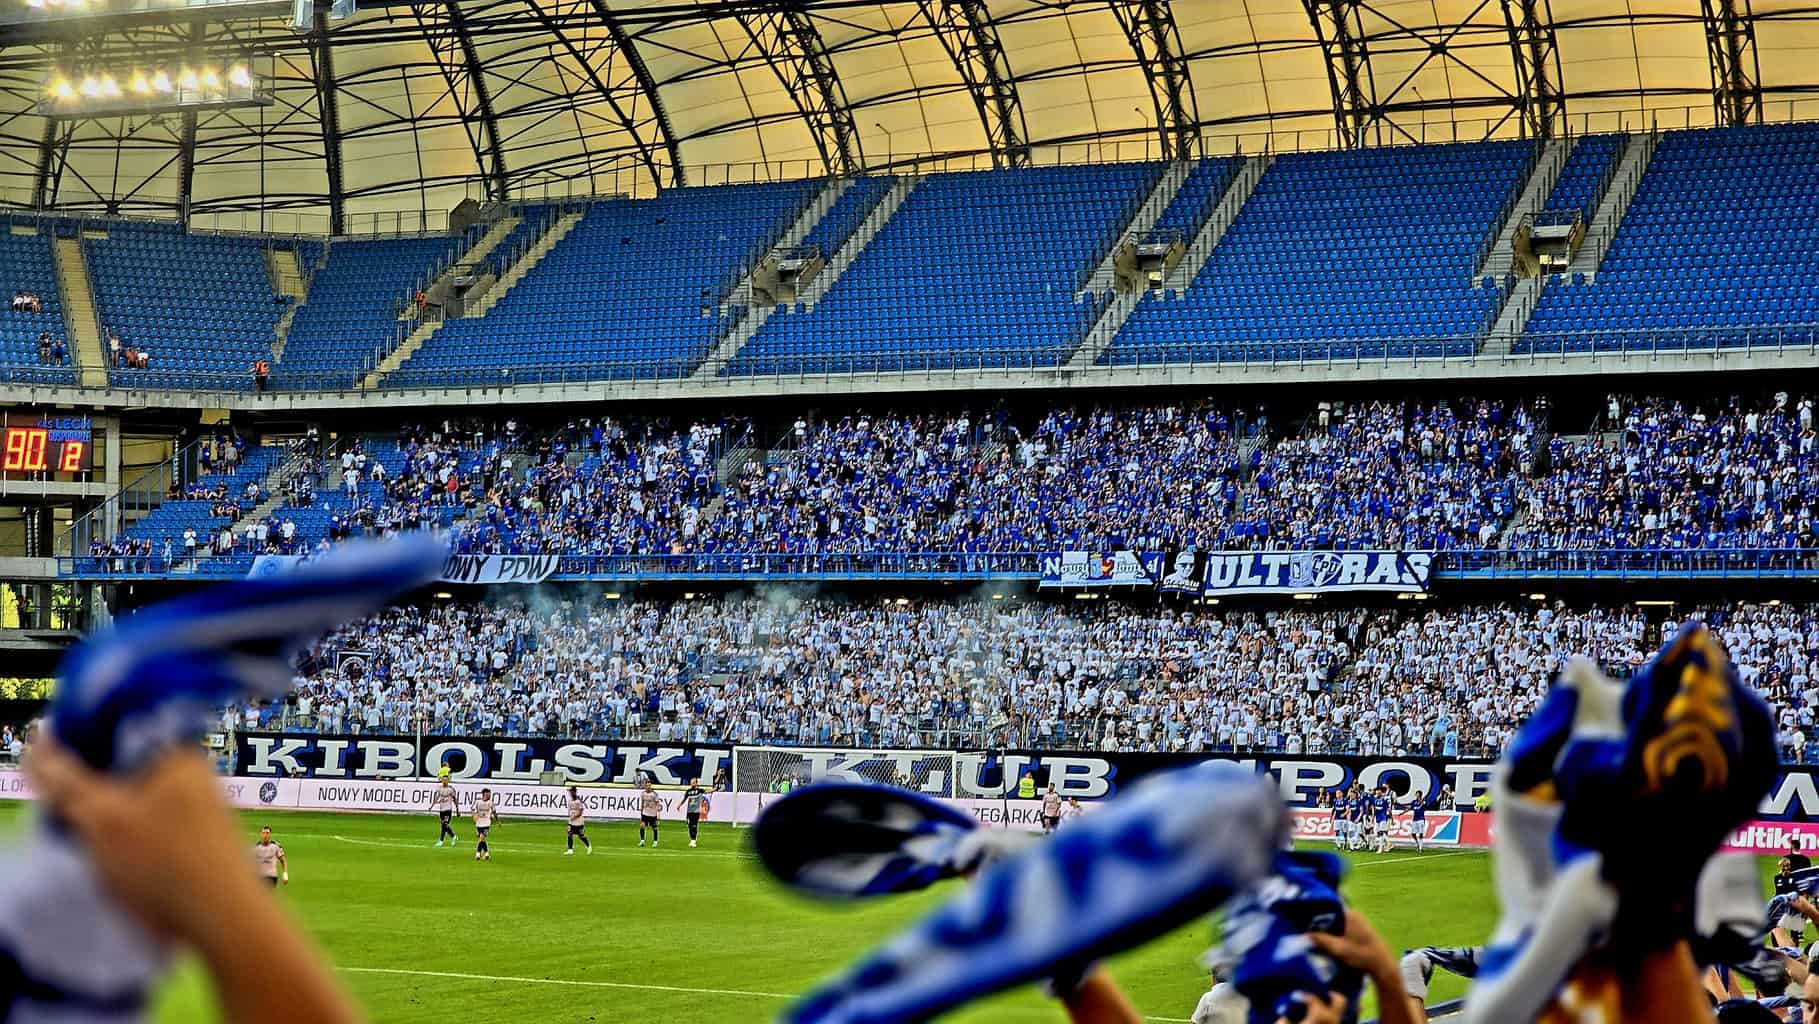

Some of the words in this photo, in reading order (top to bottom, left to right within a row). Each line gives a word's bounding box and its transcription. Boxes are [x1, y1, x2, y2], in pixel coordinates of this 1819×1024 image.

[246, 736, 730, 786] KIBOLSKI
[318, 786, 360, 802] NOWY
[361, 788, 409, 804] MODEL
[504, 792, 568, 810] ZEGARKA
